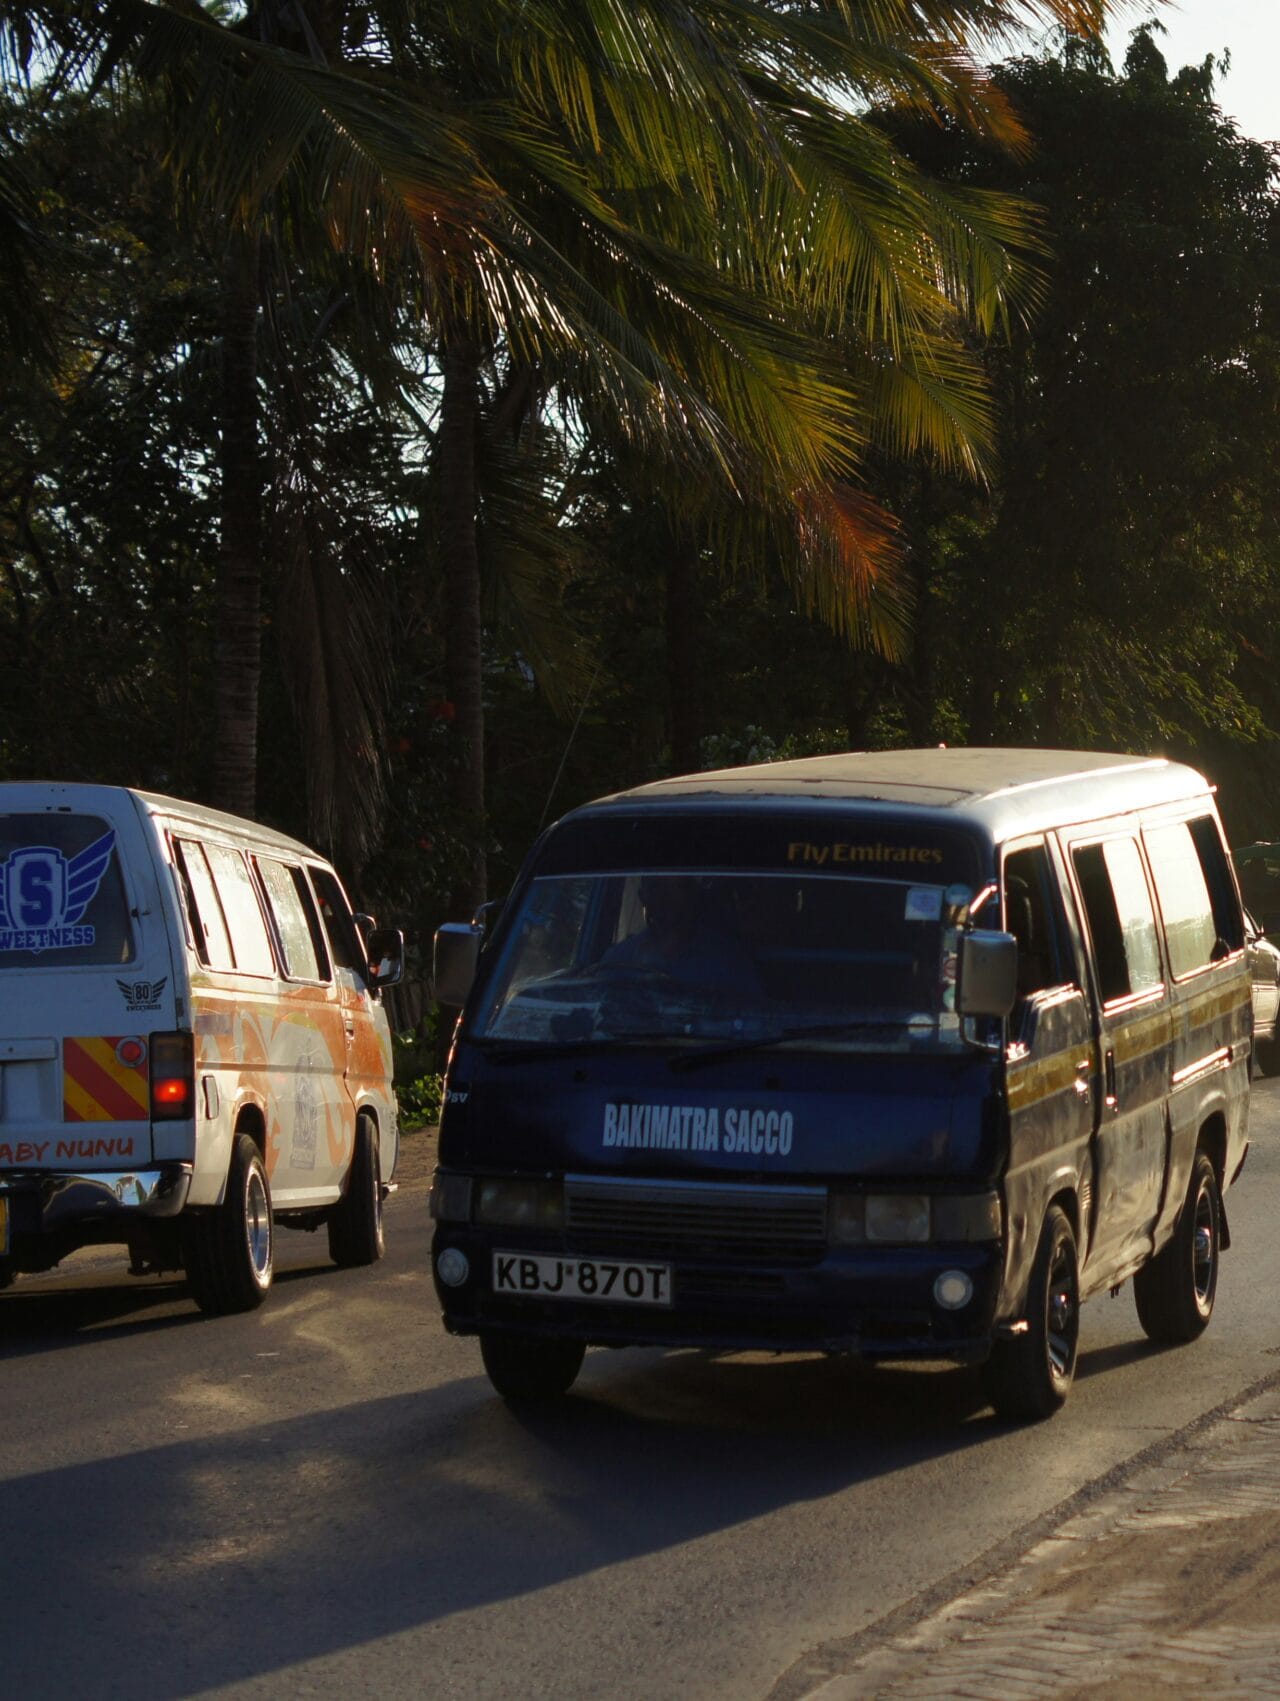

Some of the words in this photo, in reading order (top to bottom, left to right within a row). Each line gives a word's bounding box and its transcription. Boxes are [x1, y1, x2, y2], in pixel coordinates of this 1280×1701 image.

[788, 843, 829, 864] Fly
[833, 842, 943, 863] Emirates
[20, 860, 53, 926] S
[135, 984, 149, 1000] 80
[603, 1103, 719, 1151] BAKIMATRA
[723, 1108, 793, 1156] SACCO
[56, 1137, 134, 1158] NUNU
[497, 1257, 564, 1292] KBJ
[577, 1261, 667, 1299] 870T
